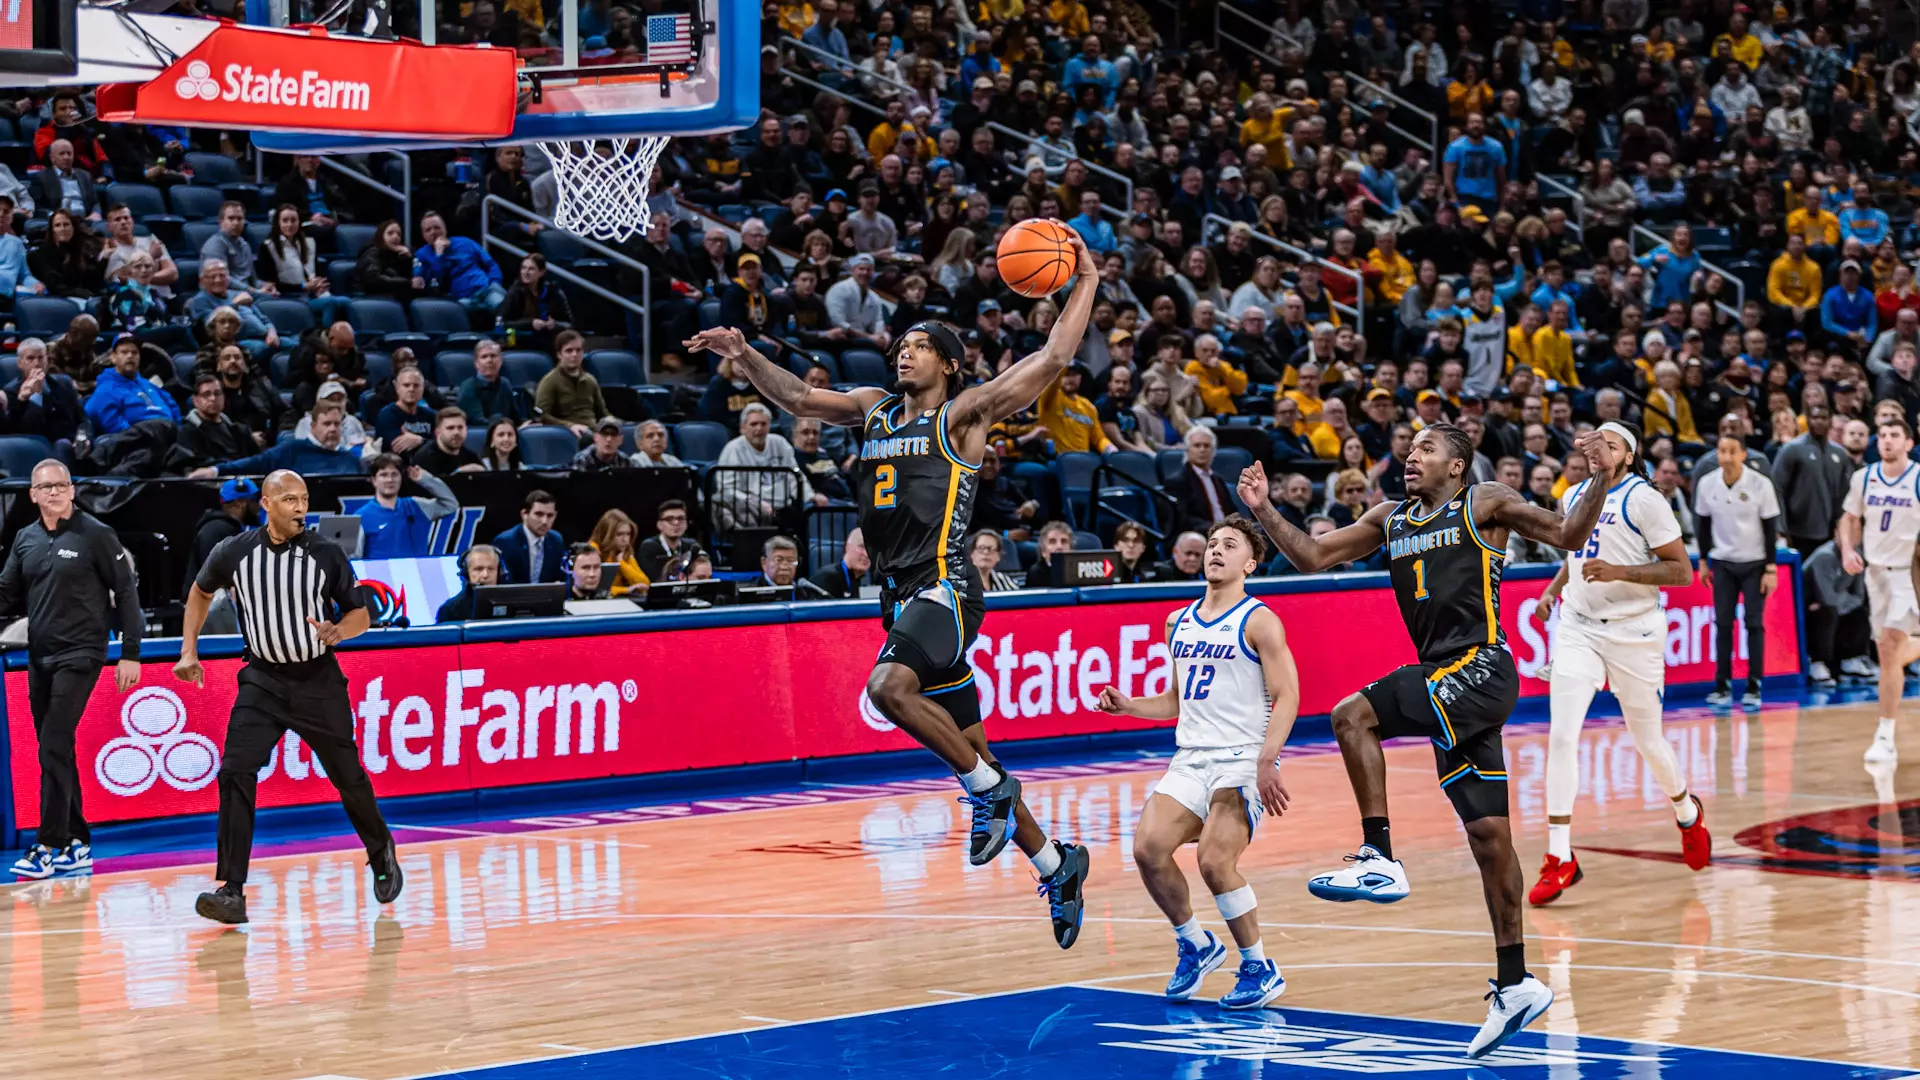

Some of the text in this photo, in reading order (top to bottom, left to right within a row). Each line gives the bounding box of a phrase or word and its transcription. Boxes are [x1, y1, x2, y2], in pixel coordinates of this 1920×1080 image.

[874, 464, 897, 509] 2
[1880, 510, 1892, 531] 0
[1389, 526, 1461, 561] MARQUETTE
[1078, 561, 1104, 579] POSS
[1412, 559, 1430, 601] 1
[965, 623, 1177, 722] StateFa
[1184, 664, 1216, 701] 12
